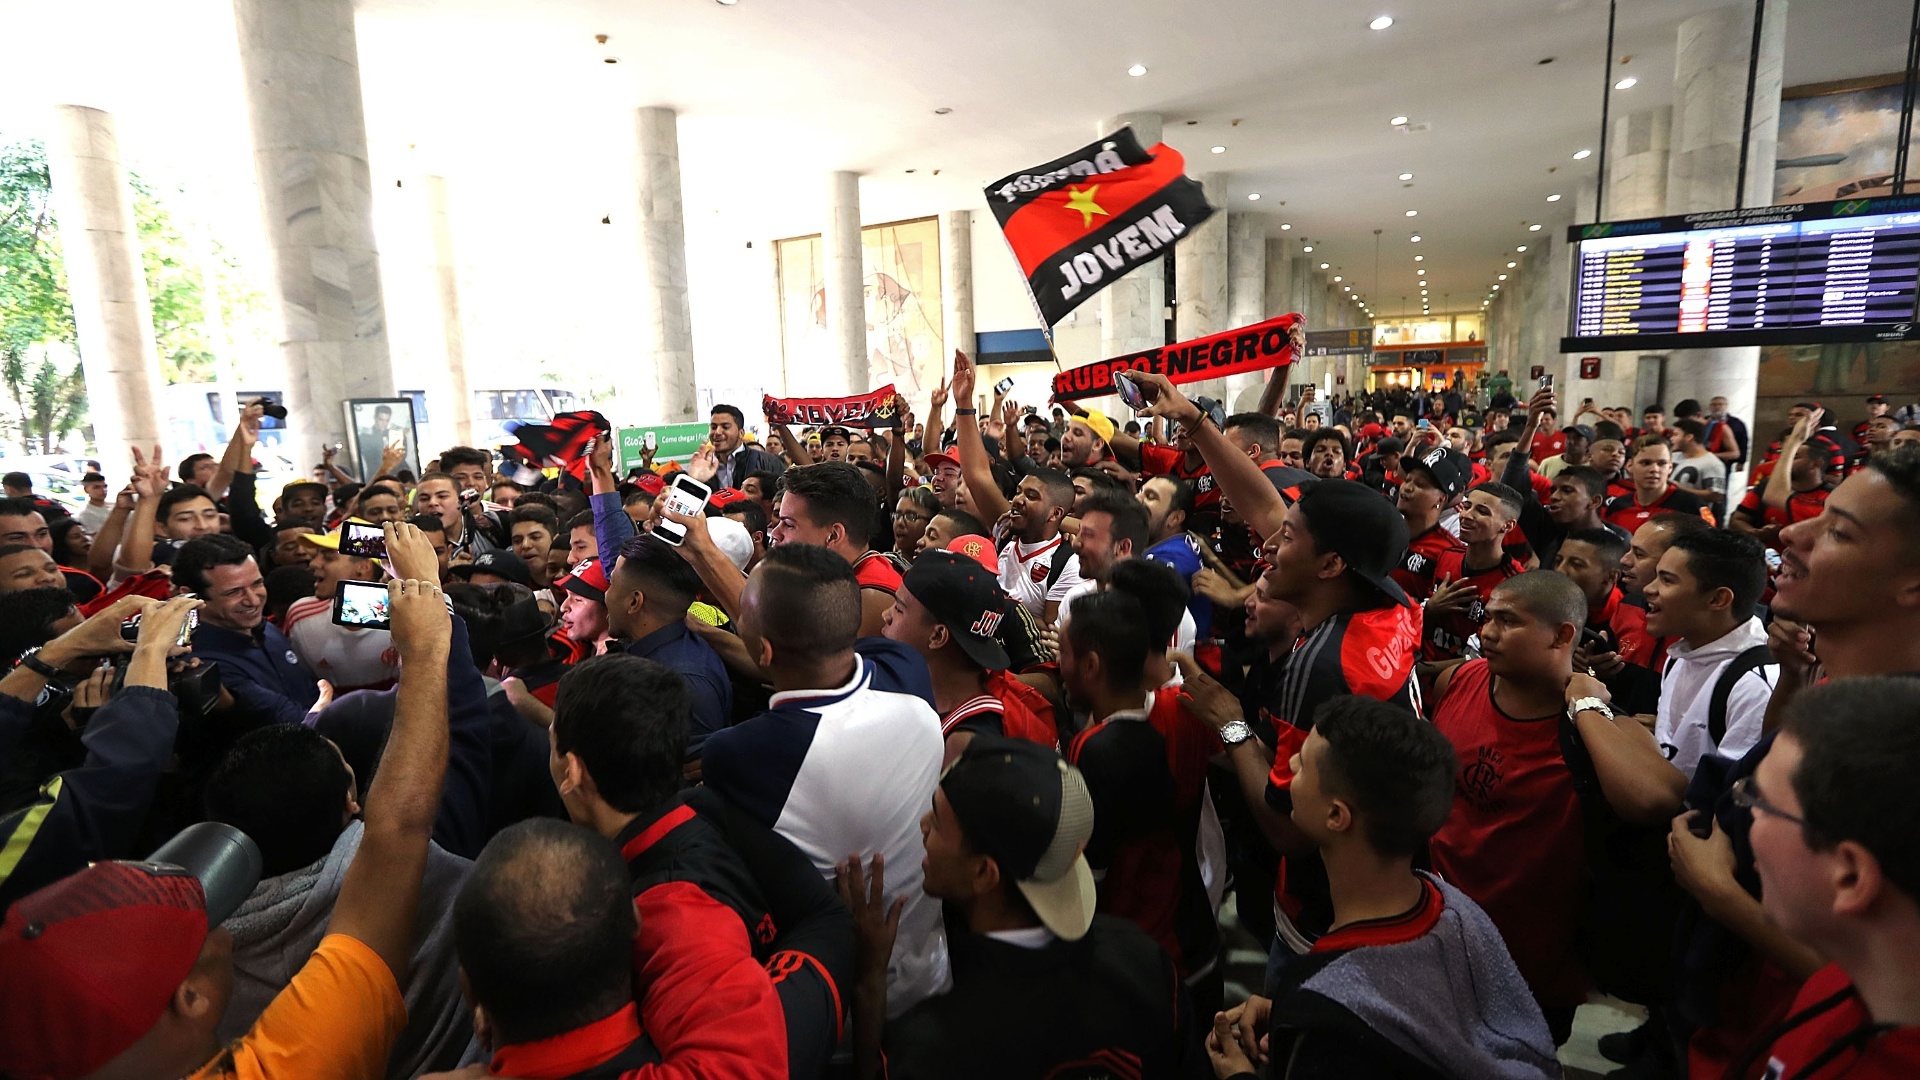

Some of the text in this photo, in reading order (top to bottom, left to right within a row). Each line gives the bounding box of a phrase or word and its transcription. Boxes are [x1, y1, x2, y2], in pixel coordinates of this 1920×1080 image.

[1059, 203, 1187, 301] JOVEM
[1166, 327, 1289, 376] NEGRO
[661, 435, 677, 444] Como
[677, 434, 695, 443] chegar
